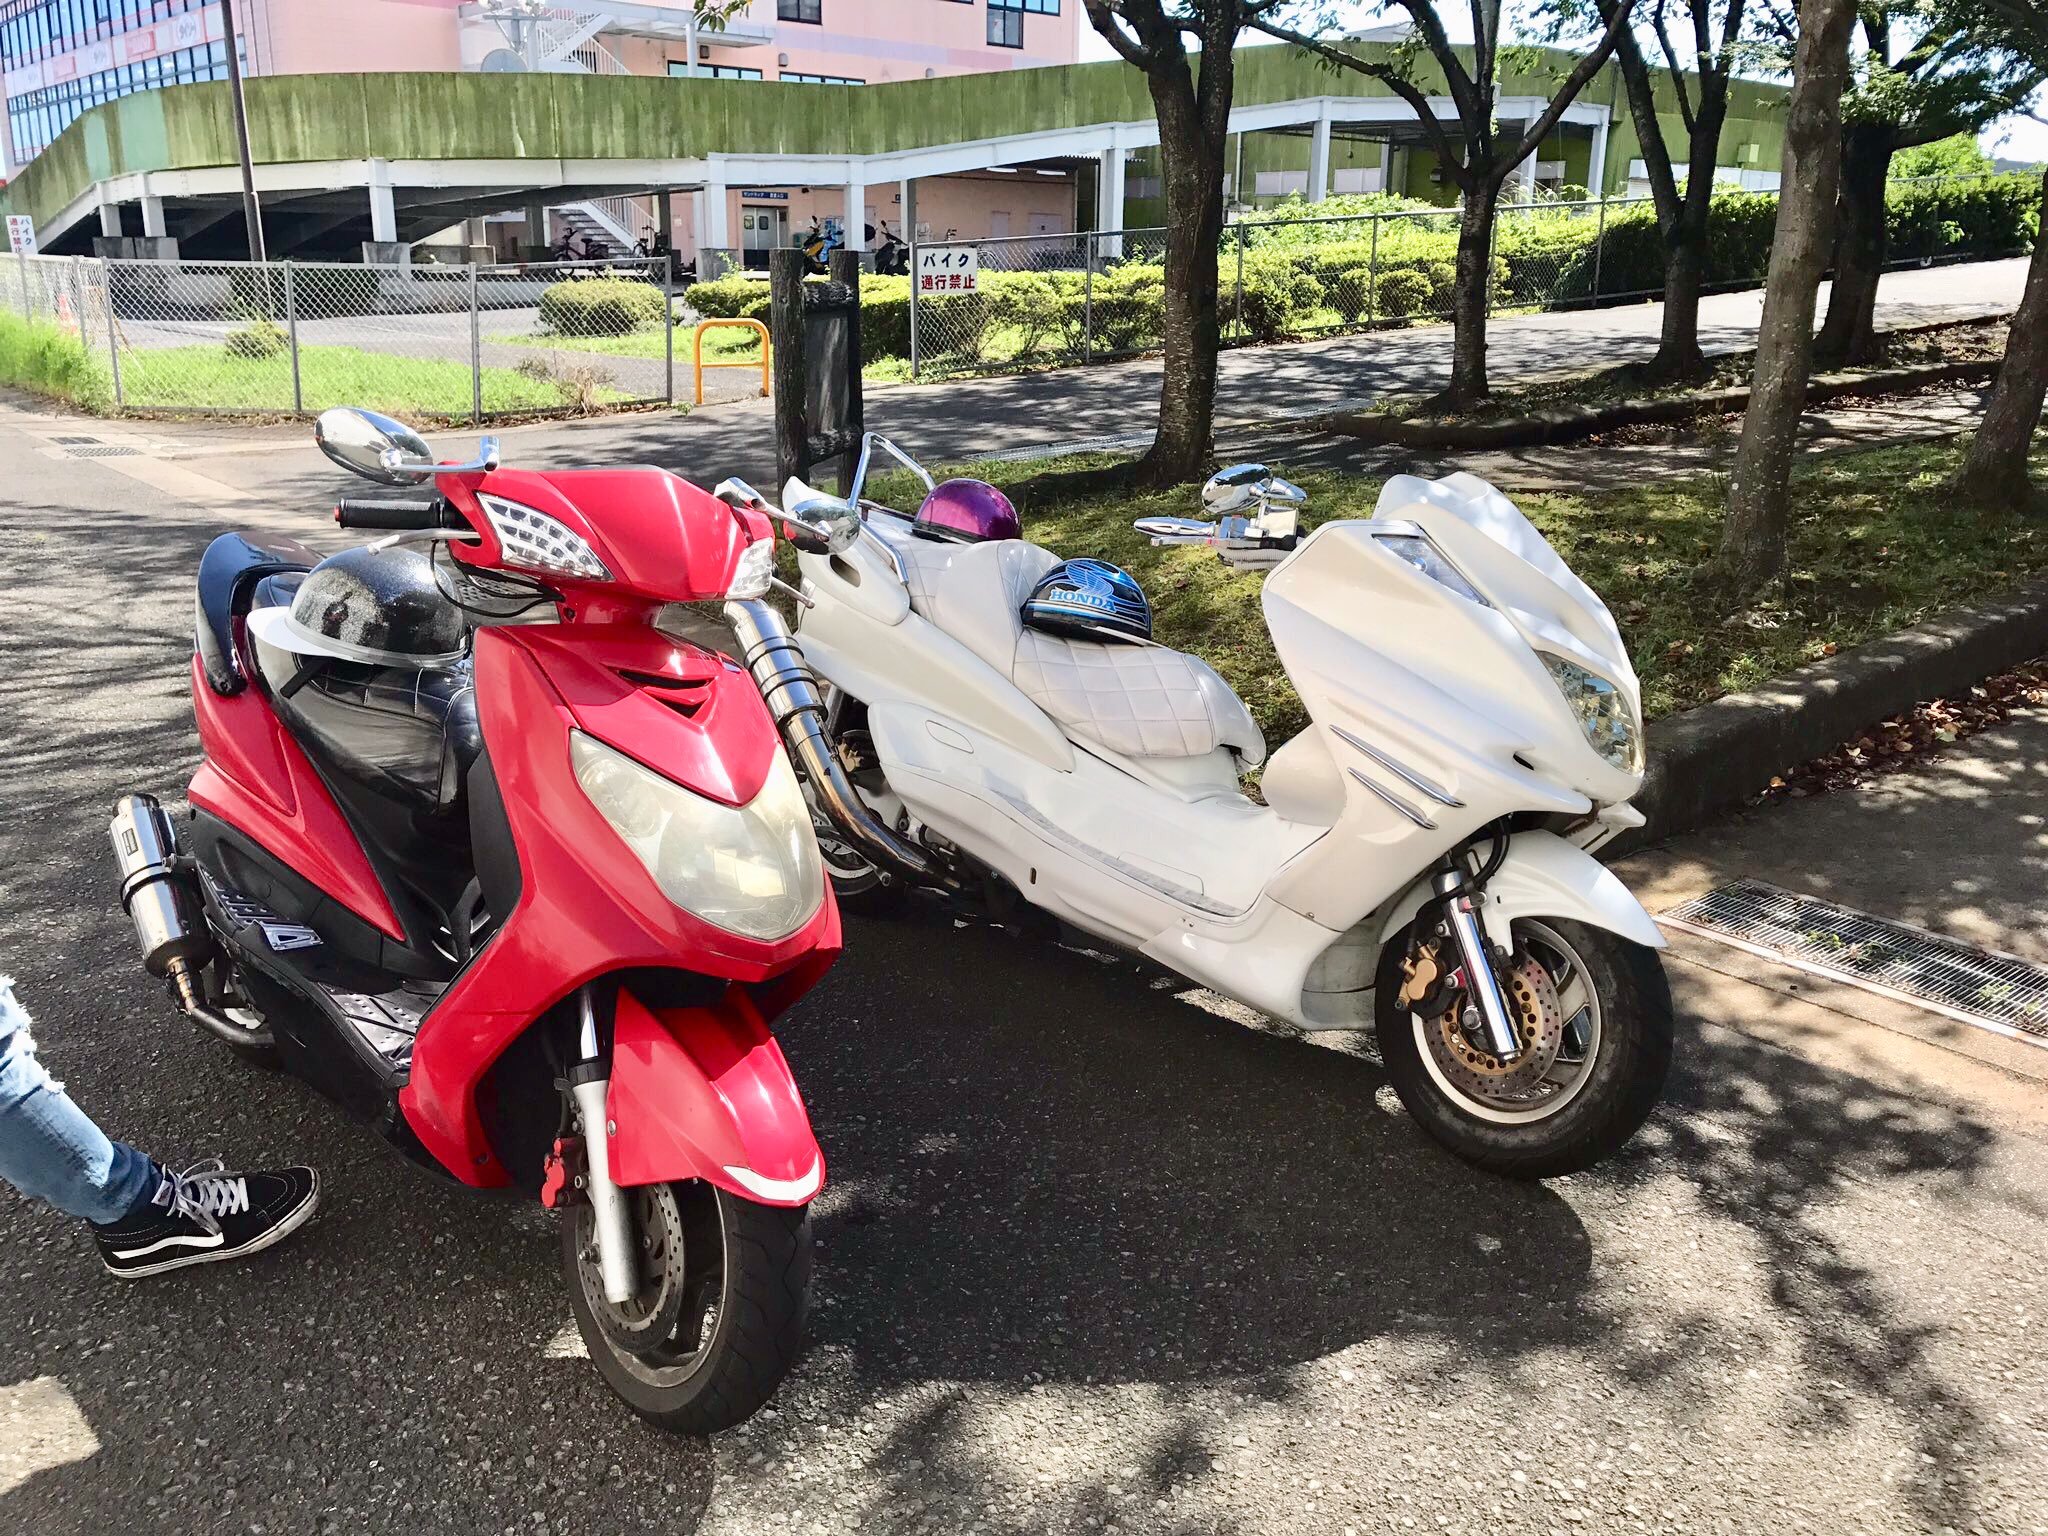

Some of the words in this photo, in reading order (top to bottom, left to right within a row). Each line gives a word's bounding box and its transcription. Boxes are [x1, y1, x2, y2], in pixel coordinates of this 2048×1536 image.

[923, 252, 969, 268] バイク
[921, 273, 975, 290] 通行禁止
[1050, 590, 1116, 612] HONDA
